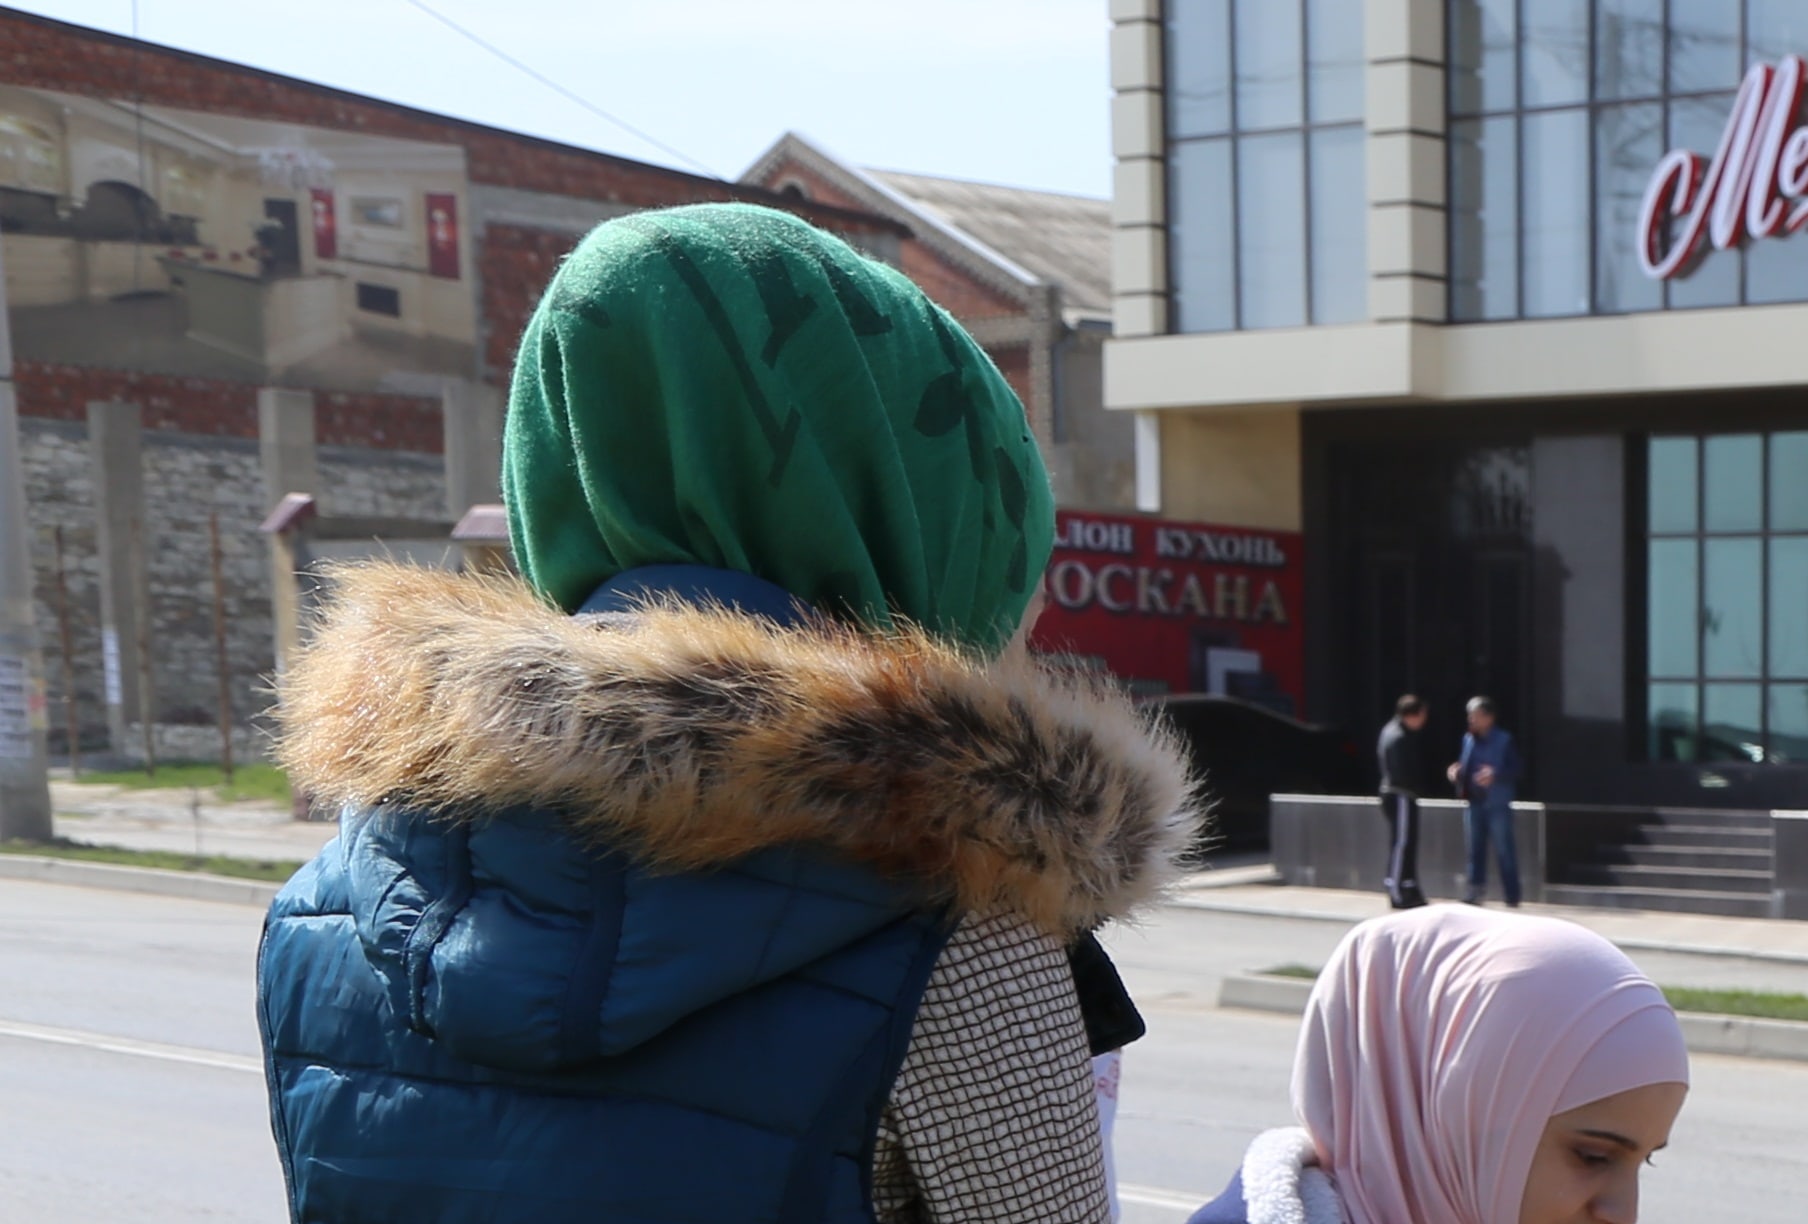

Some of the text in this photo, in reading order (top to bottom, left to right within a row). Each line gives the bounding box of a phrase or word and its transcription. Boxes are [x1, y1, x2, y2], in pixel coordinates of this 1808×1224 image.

[1054, 518, 1286, 567] ЛОН КУХОНЬ
[1048, 559, 1289, 625] ОСКАНА
